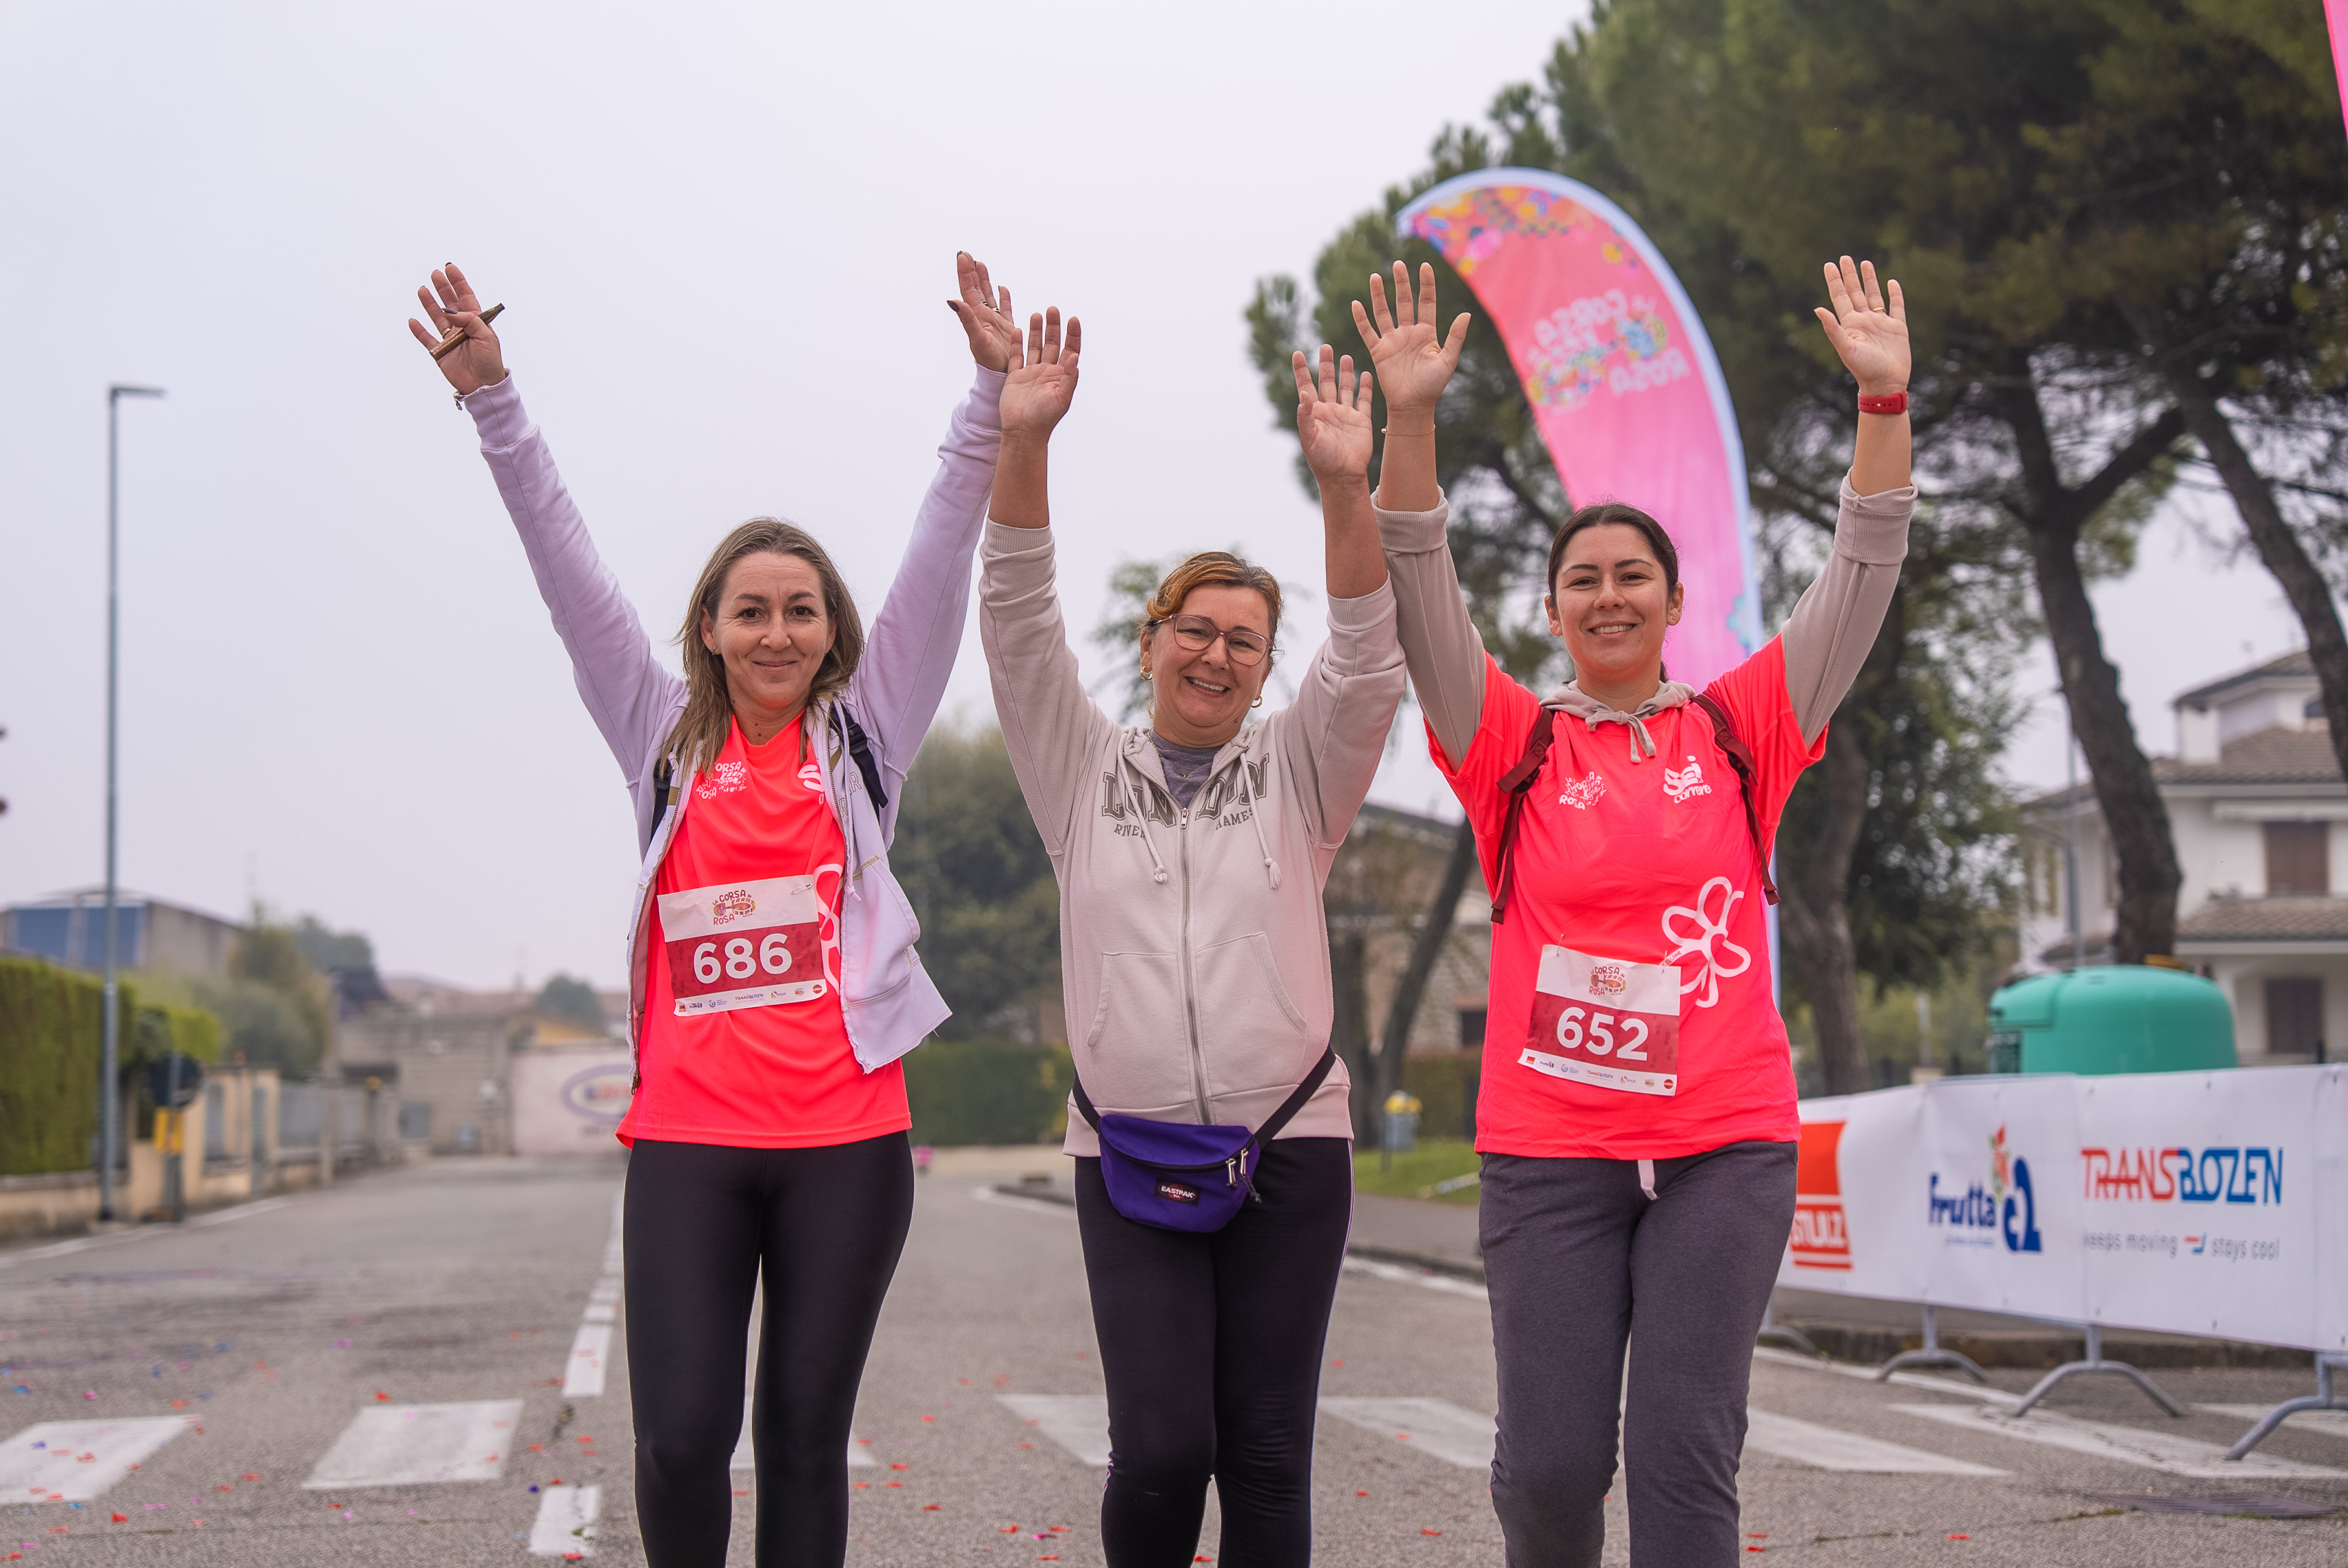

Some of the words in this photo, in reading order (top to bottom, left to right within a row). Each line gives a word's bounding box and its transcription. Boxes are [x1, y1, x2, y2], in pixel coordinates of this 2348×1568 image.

[715, 761, 741, 773] ORSA
[719, 890, 746, 902] CORSA
[713, 914, 735, 925] ROSA
[693, 933, 792, 984] 686
[1595, 966, 1620, 975] CORSA
[1588, 986, 1605, 996] ROSA
[1556, 1006, 1649, 1061] 652
[2080, 1147, 2283, 1205] TRANSBOZEN
[1161, 1186, 1193, 1198] EASTPAK
[1929, 1172, 1996, 1227] Frutta
[2126, 1231, 2178, 1259] moving
[2252, 1237, 2281, 1261] cool
